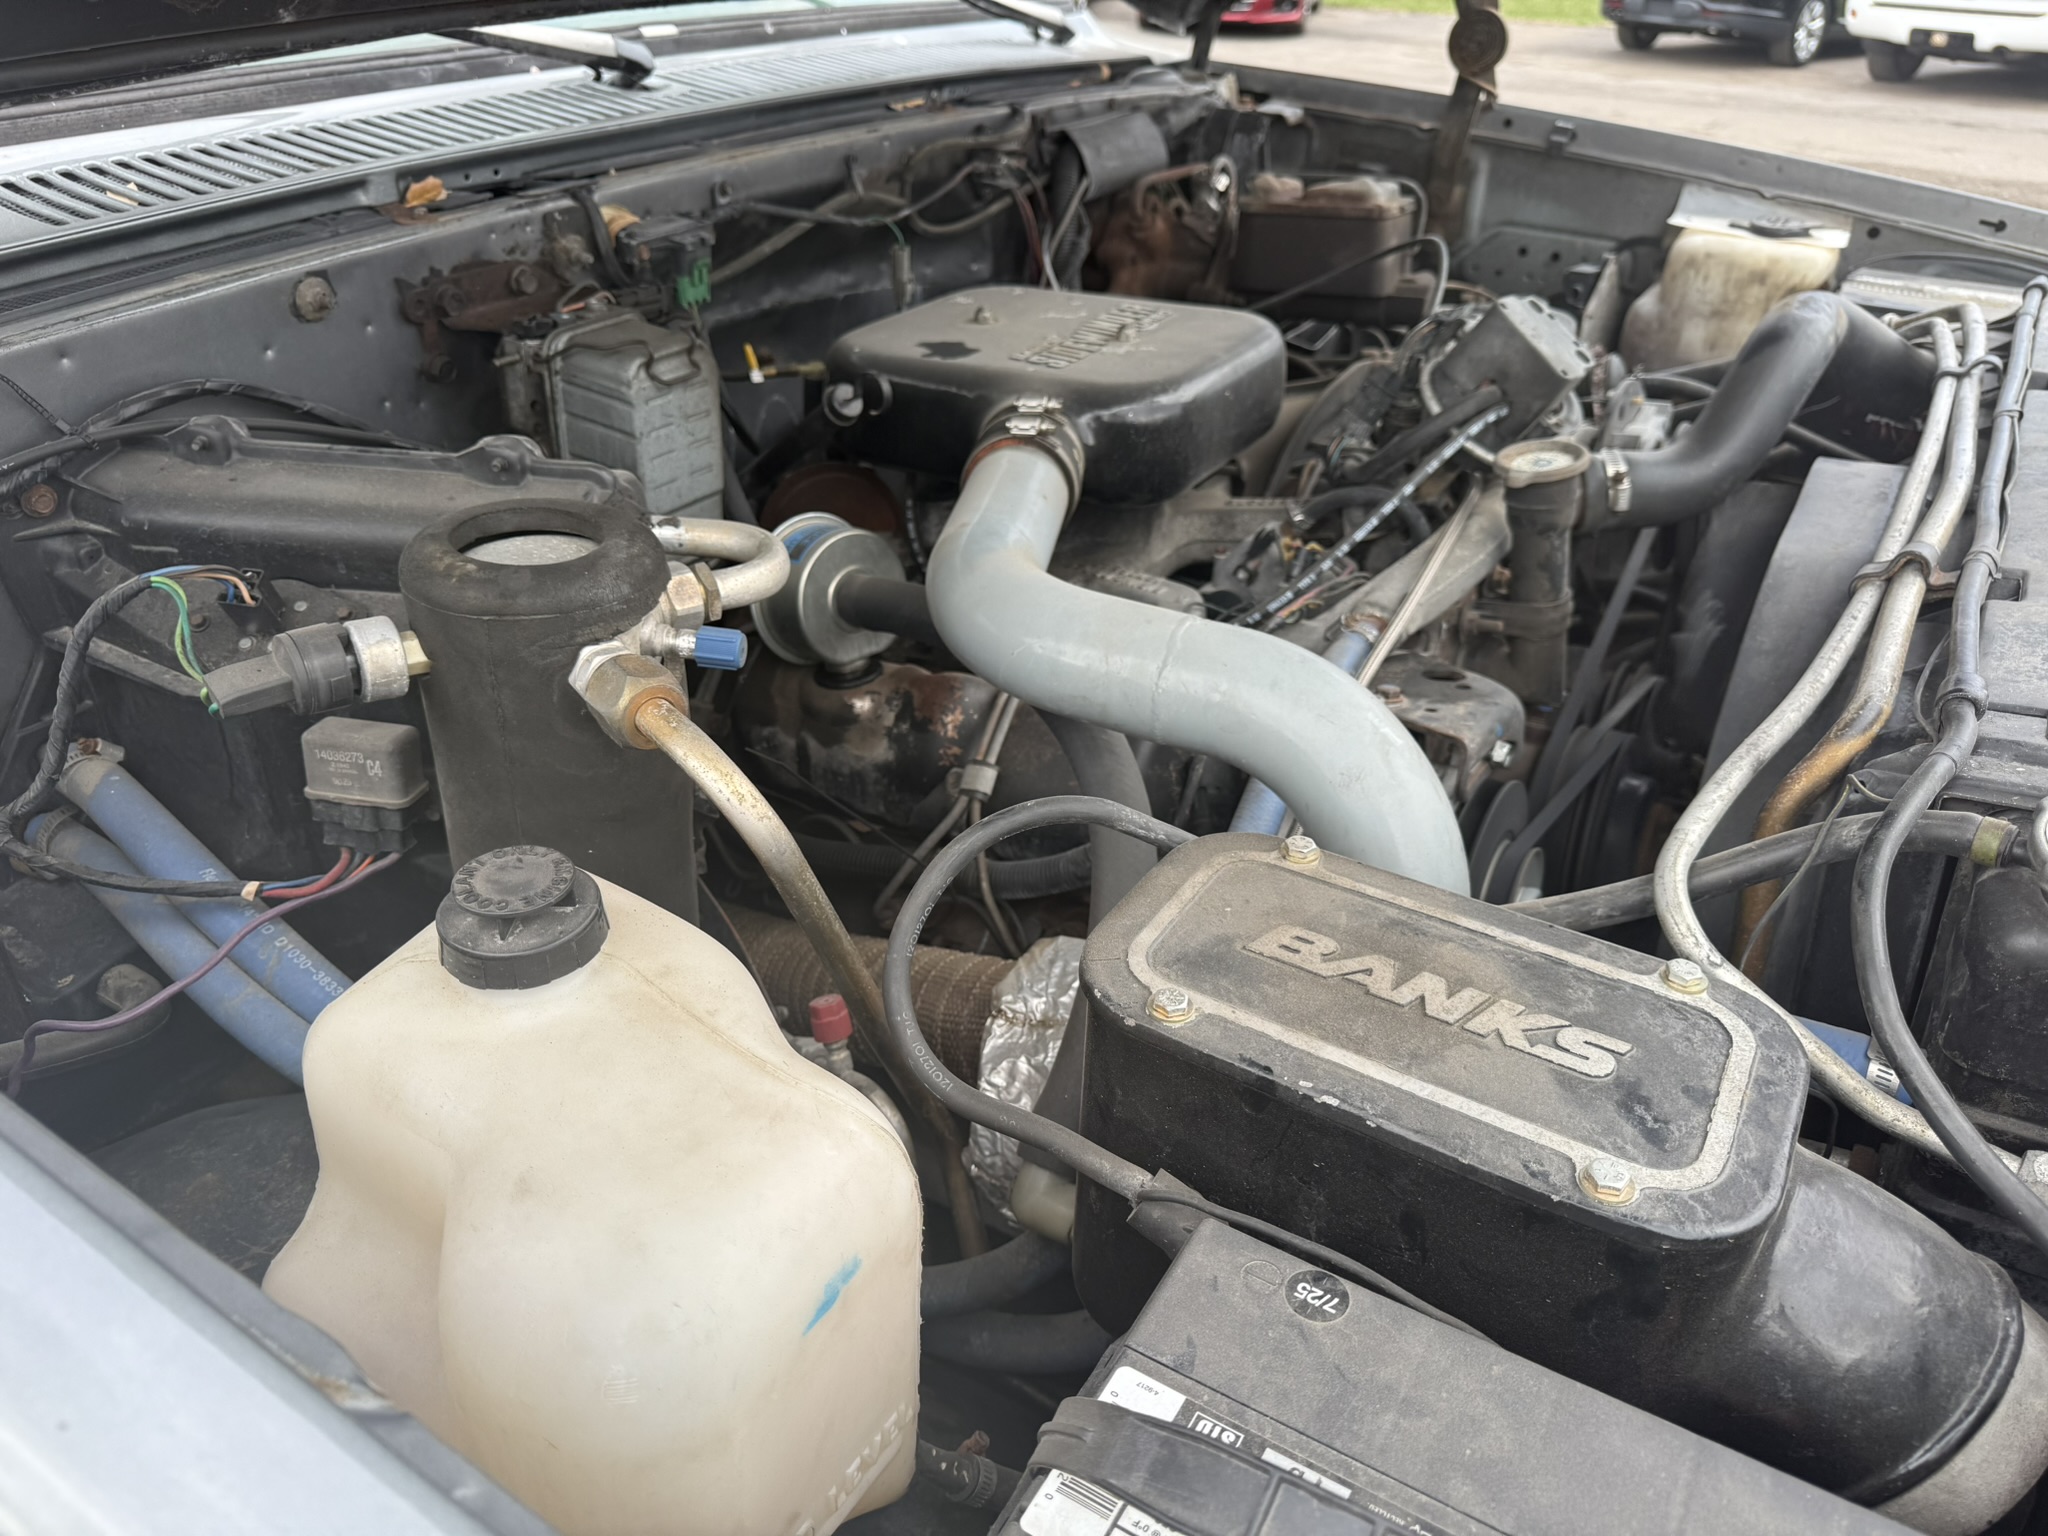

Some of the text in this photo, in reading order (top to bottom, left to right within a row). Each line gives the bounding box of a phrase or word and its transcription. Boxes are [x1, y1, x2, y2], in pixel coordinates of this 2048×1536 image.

[1242, 925, 1635, 1079] BANKS
[912, 1042, 954, 1092] 12012701
[1293, 1281, 1340, 1315] 7/25
